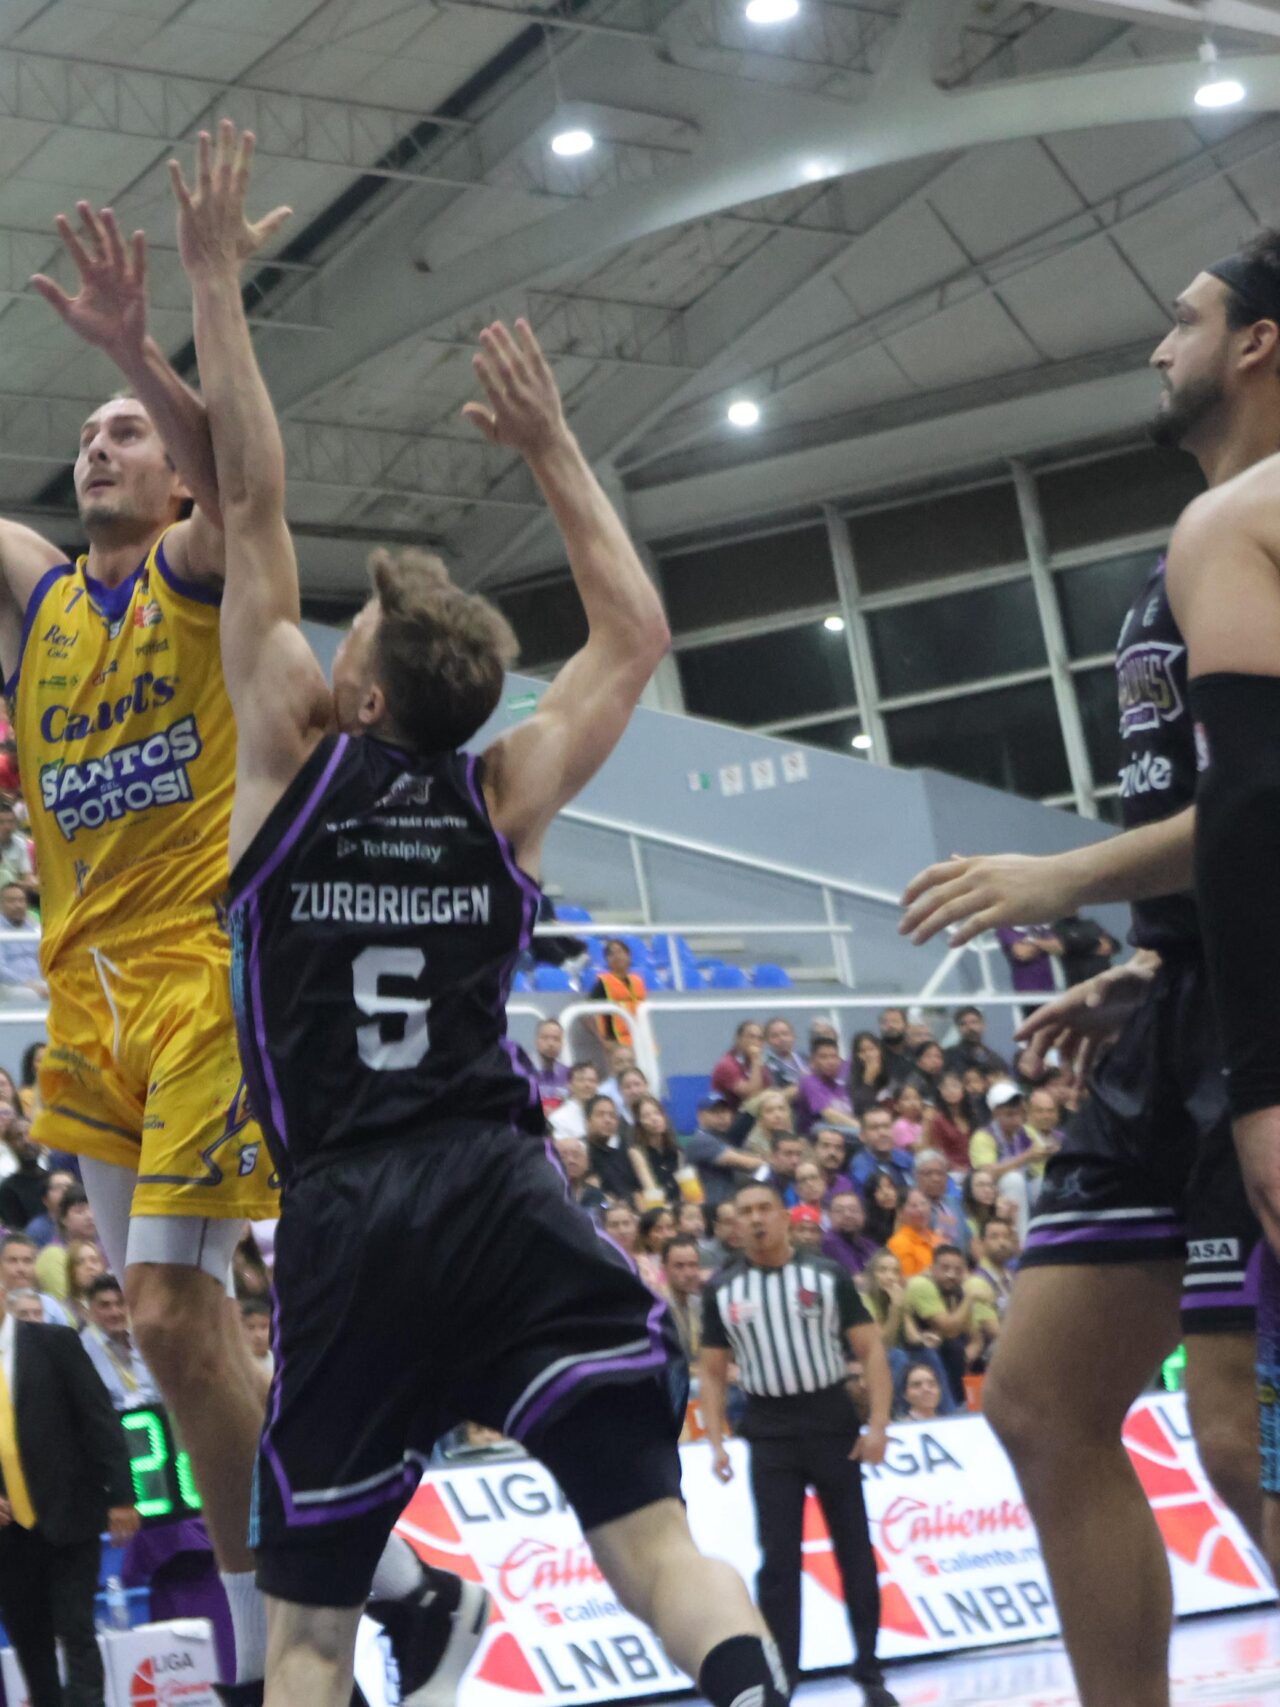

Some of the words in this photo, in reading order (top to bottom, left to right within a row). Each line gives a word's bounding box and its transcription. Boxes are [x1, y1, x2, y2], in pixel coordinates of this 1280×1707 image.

[41, 719, 198, 807] SANTOS
[56, 767, 190, 840] POTOSI
[361, 839, 442, 864] Totalplay
[290, 882, 489, 926] ZURBRIGGEN
[1186, 1242, 1233, 1259] ASA
[862, 1434, 964, 1480] GA
[443, 1473, 567, 1524] LIG
[917, 1580, 1049, 1638] LNBP
